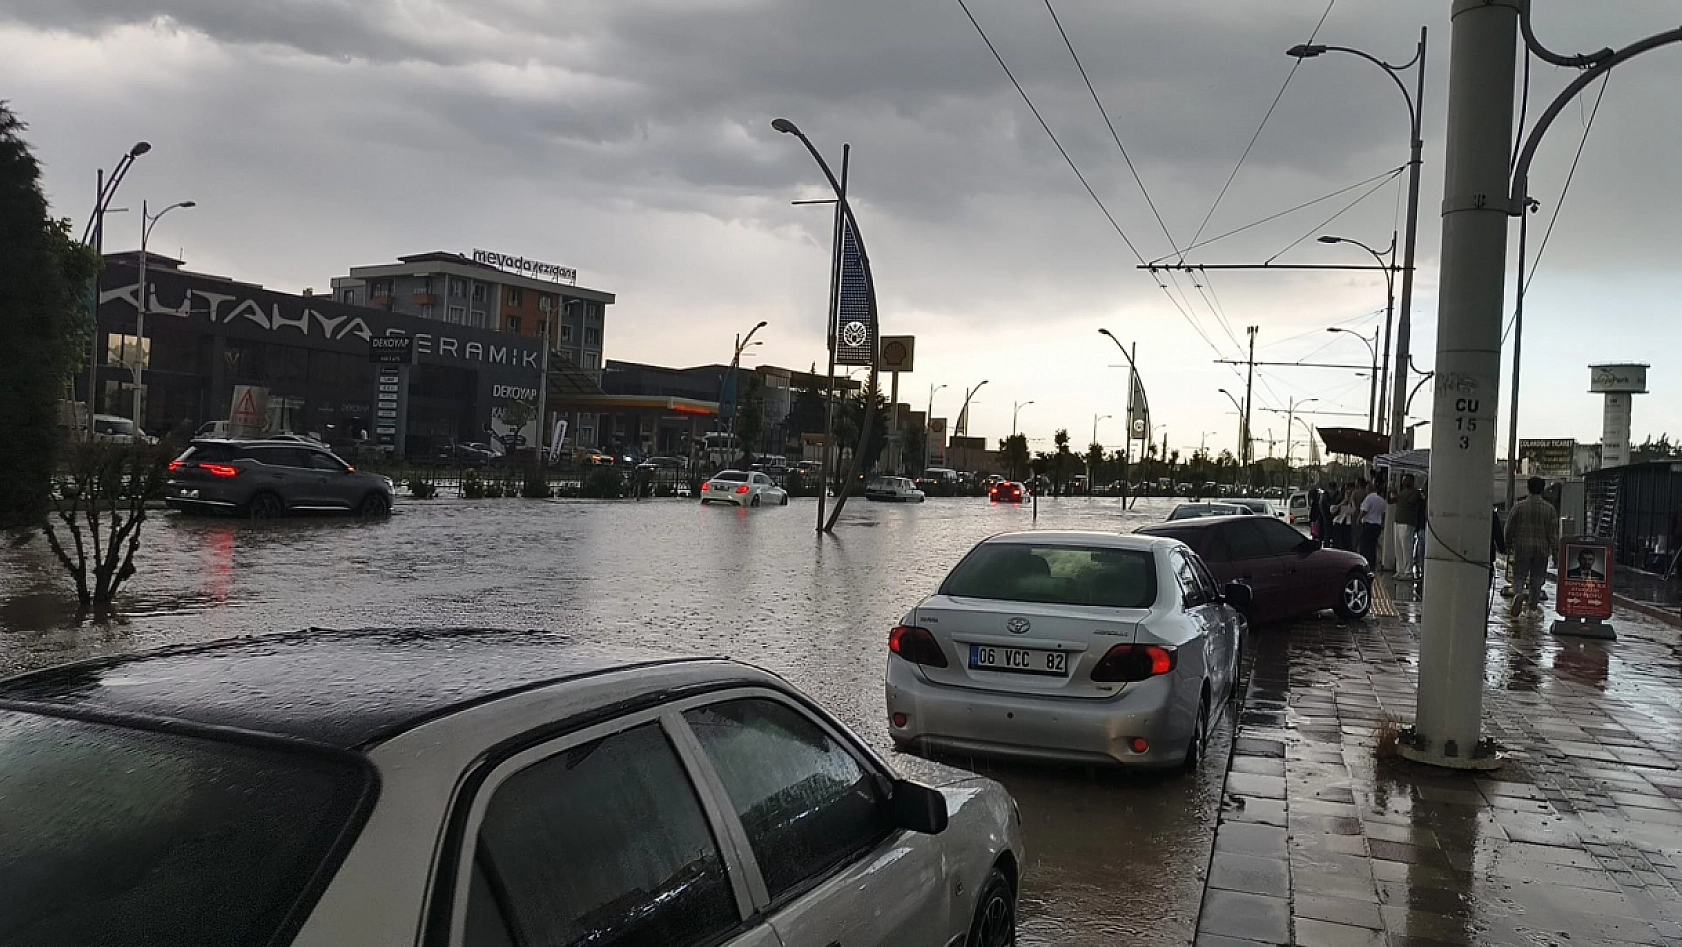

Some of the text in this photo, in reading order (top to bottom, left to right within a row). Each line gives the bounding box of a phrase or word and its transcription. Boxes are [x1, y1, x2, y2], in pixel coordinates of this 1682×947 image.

[372, 337, 410, 348] DEKOYAP
[492, 384, 537, 401] DEKOYAP
[1456, 398, 1480, 413] CU
[1456, 416, 1477, 432] 15
[1459, 435, 1469, 450] 3
[980, 648, 996, 665] 06
[1005, 649, 1030, 667] VCC
[1046, 653, 1064, 671] 82
